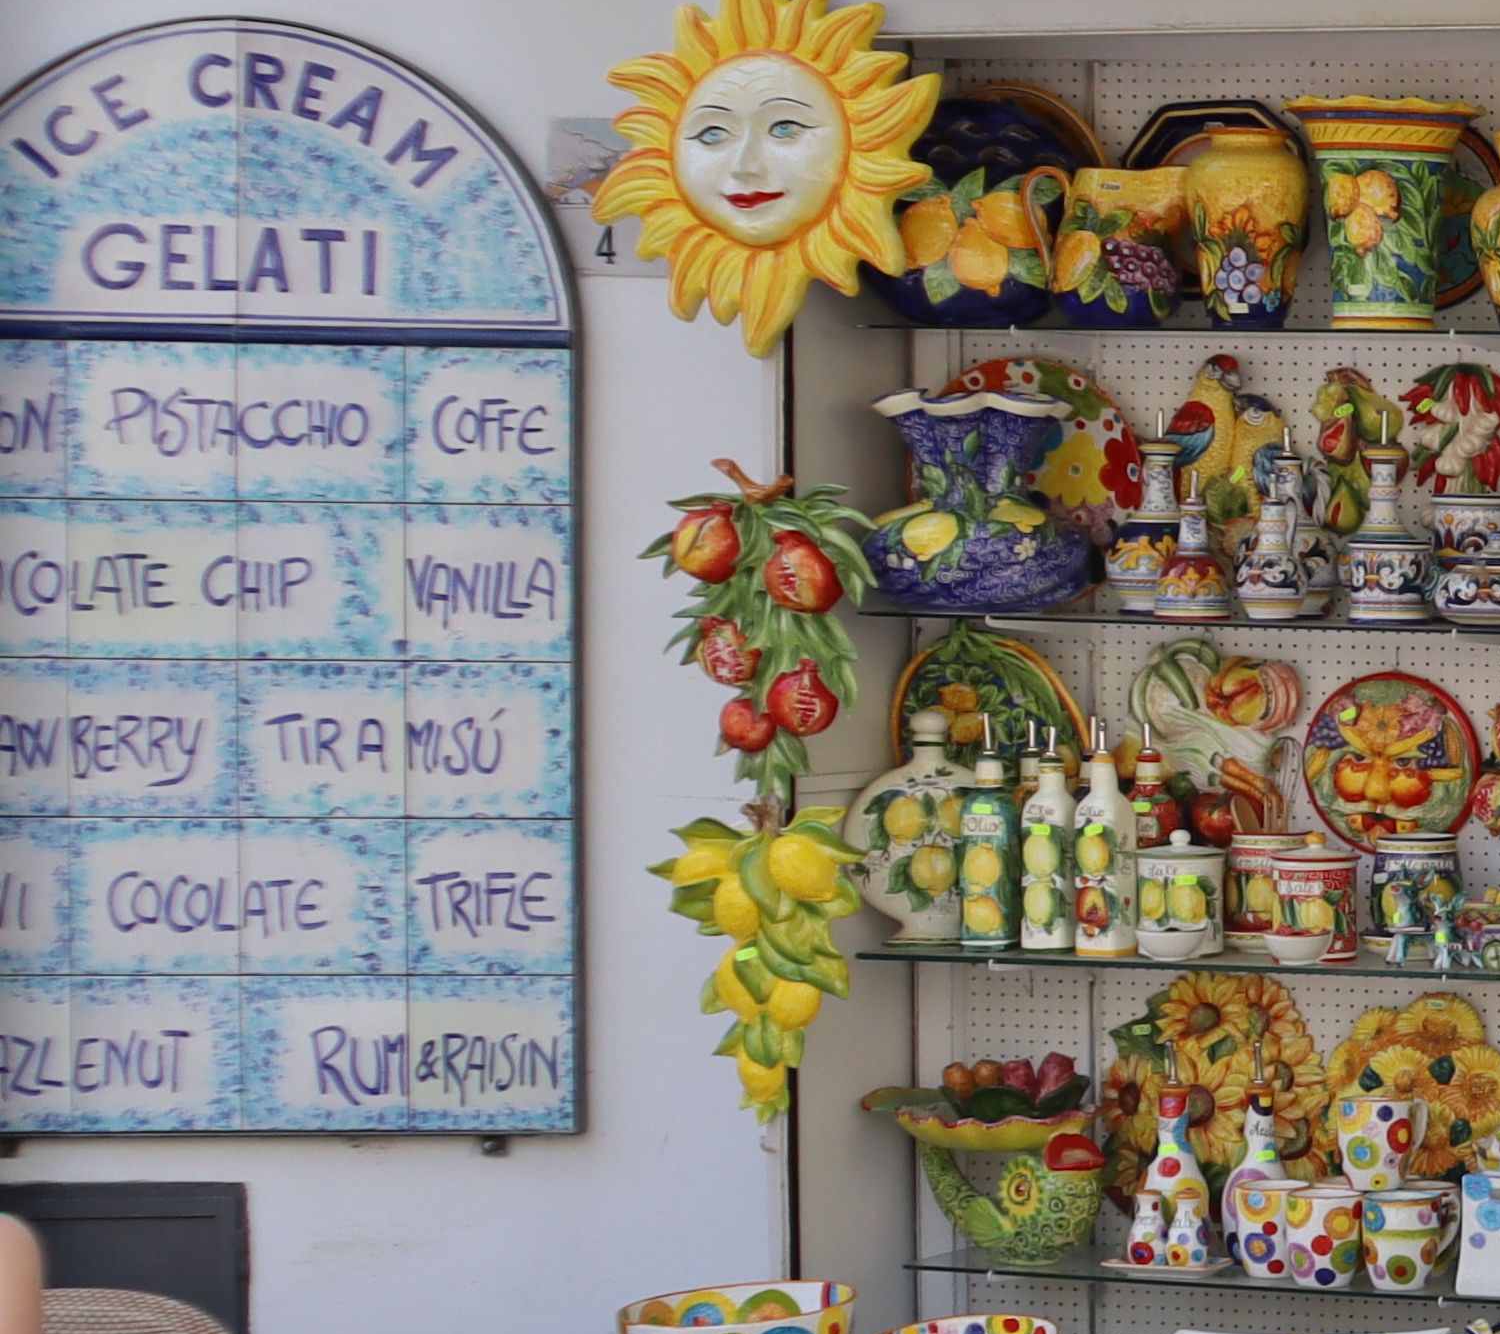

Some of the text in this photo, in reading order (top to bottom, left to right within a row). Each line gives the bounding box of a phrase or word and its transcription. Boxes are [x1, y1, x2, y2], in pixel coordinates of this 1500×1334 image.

[11, 51, 459, 189] ICE CREAM
[80, 222, 377, 297] GELATI
[595, 224, 617, 265] 4
[105, 387, 370, 456] PISTACCHIO
[432, 395, 556, 455] COFFE
[0, 550, 313, 617] COLATE CHIP
[405, 554, 558, 629] VANILLA
[107, 870, 328, 938] COCOLATE
[414, 871, 557, 939] TRIFLE
[309, 1024, 408, 1106] RUM
